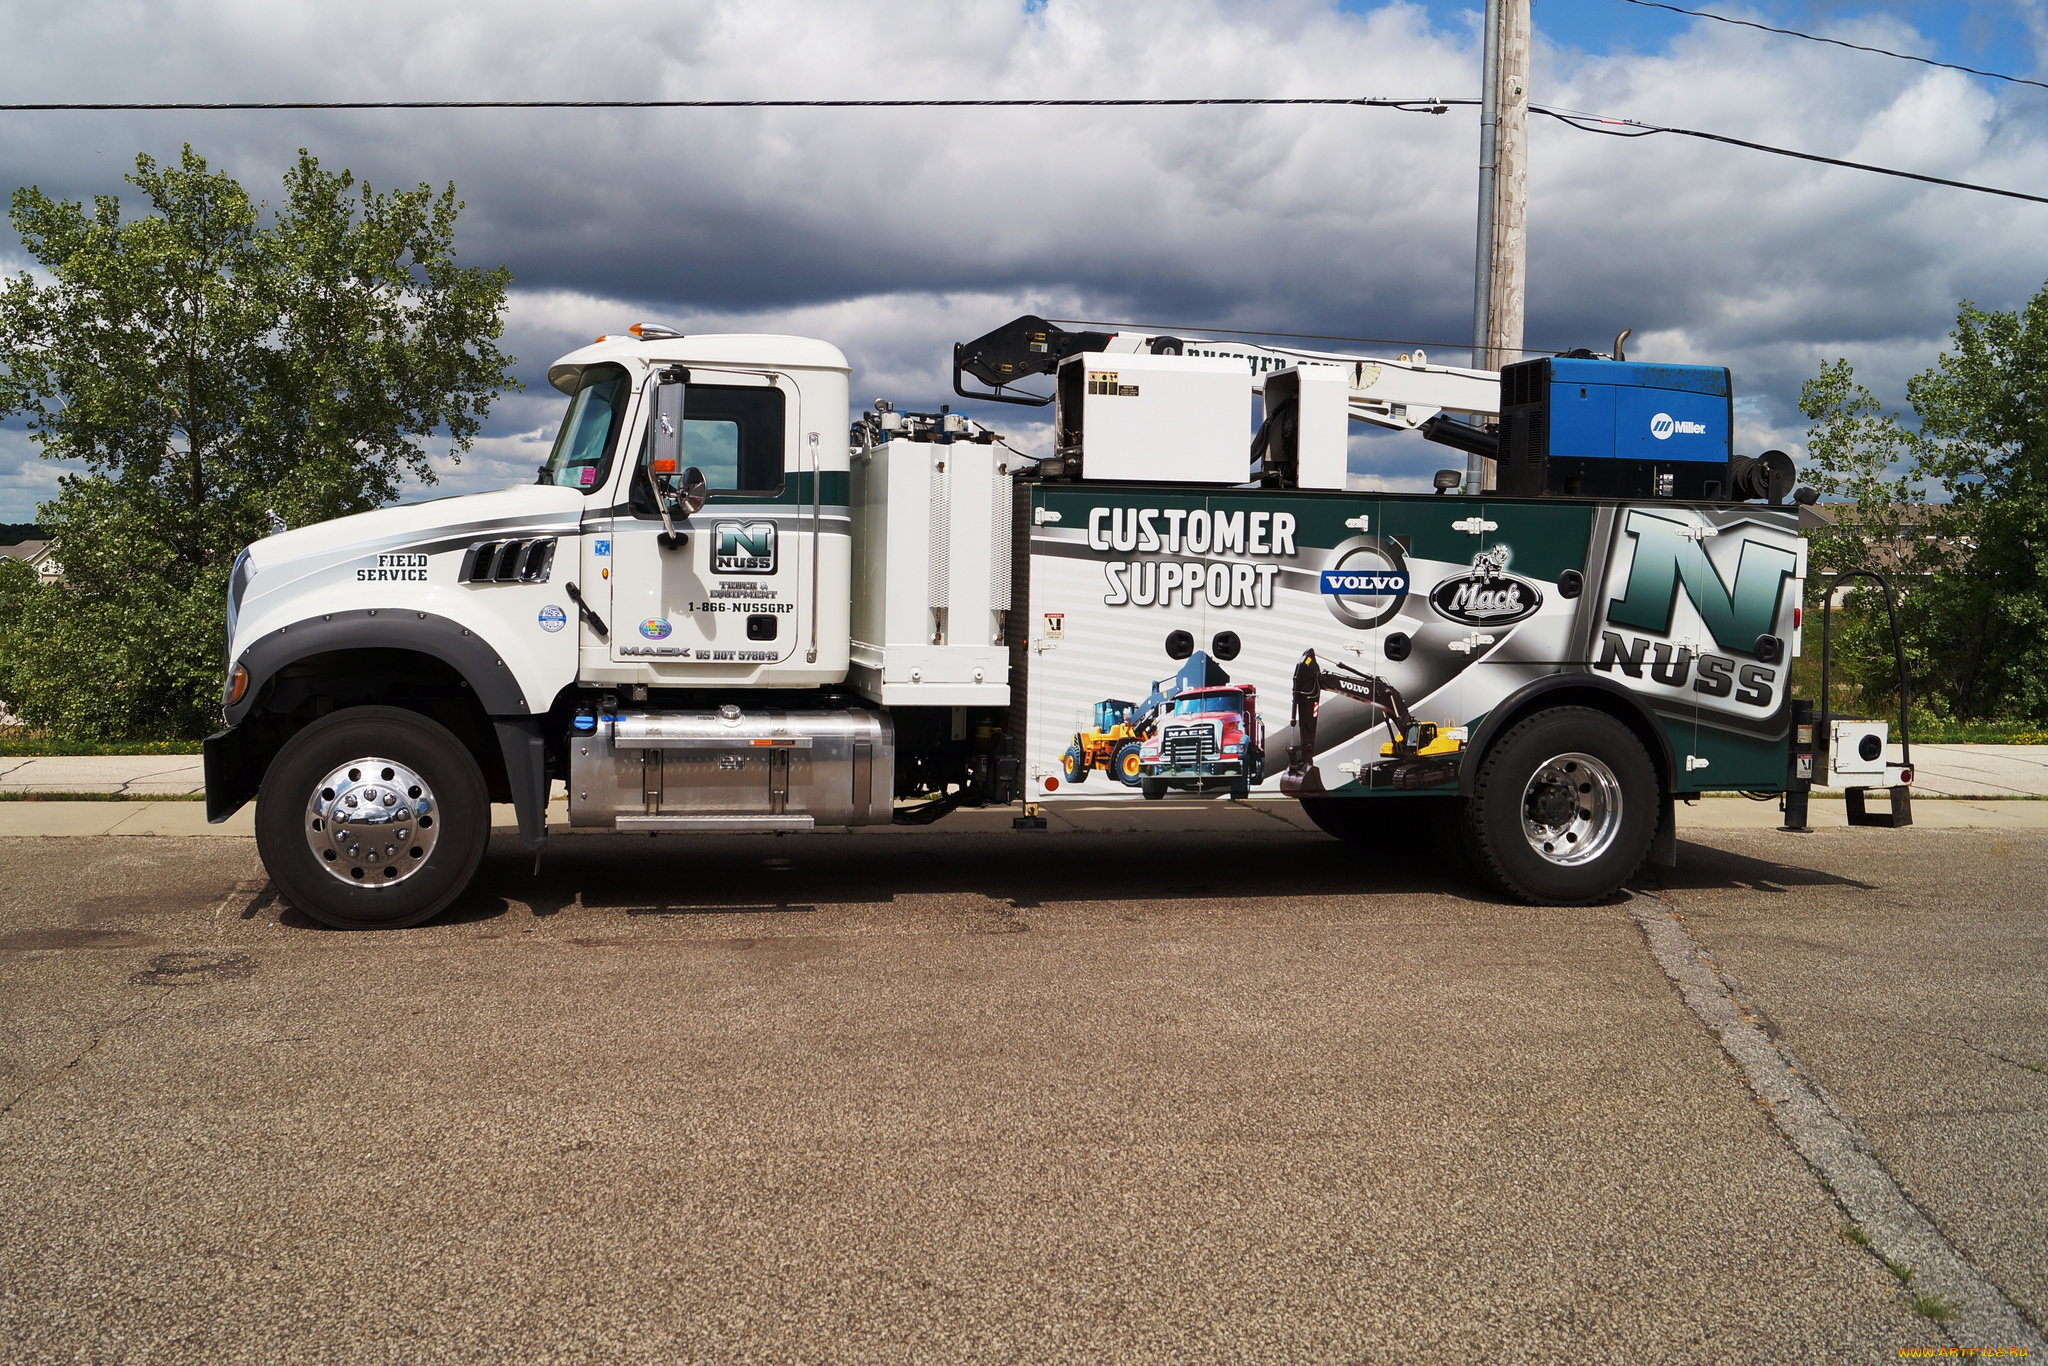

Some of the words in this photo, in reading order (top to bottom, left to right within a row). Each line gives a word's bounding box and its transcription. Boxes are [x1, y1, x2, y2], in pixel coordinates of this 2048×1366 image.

[1087, 506, 1297, 556] CUSTOMER
[378, 554, 428, 567] FIELD
[717, 556, 771, 569] NUSS
[356, 569, 428, 581] SERVICE
[718, 581, 758, 590] TRUCK
[759, 581, 769, 590] &
[1103, 560, 1279, 608] SUPPORT
[1325, 575, 1405, 590] VOLVO
[709, 589, 778, 599] EQUIPMENT
[1448, 582, 1525, 619] Mack
[688, 601, 794, 613] 1-866-NUSSGRP
[619, 645, 691, 657] MACK
[695, 650, 710, 660] US
[713, 650, 736, 660] DOT
[1593, 629, 1777, 708] NUSS
[1338, 679, 1371, 695] VOLVO
[1167, 729, 1211, 737] MACK
